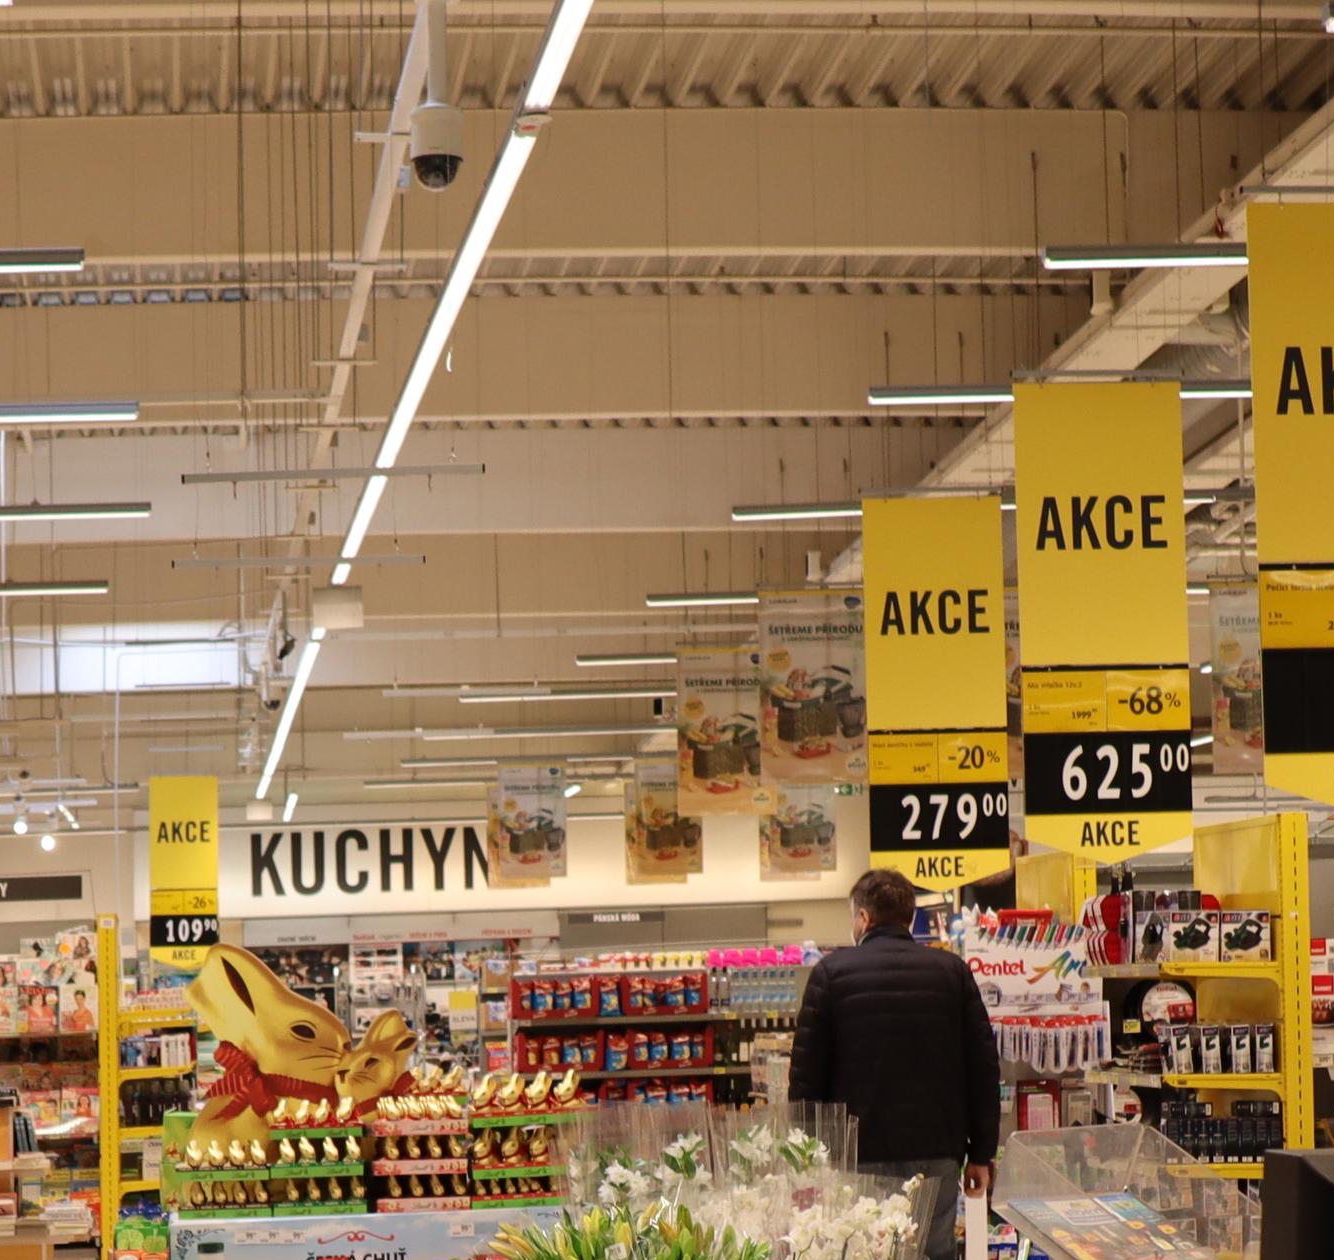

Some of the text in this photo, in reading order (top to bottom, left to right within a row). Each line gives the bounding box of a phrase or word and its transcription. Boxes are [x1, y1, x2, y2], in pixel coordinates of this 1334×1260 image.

[1035, 495, 1168, 551] AKCE
[880, 588, 990, 636] AKCE
[157, 821, 210, 843] AKCE
[1080, 820, 1141, 848] AKCE
[915, 856, 966, 878] AKCE
[172, 950, 196, 961] AKCE
[968, 957, 1027, 976] Pentel
